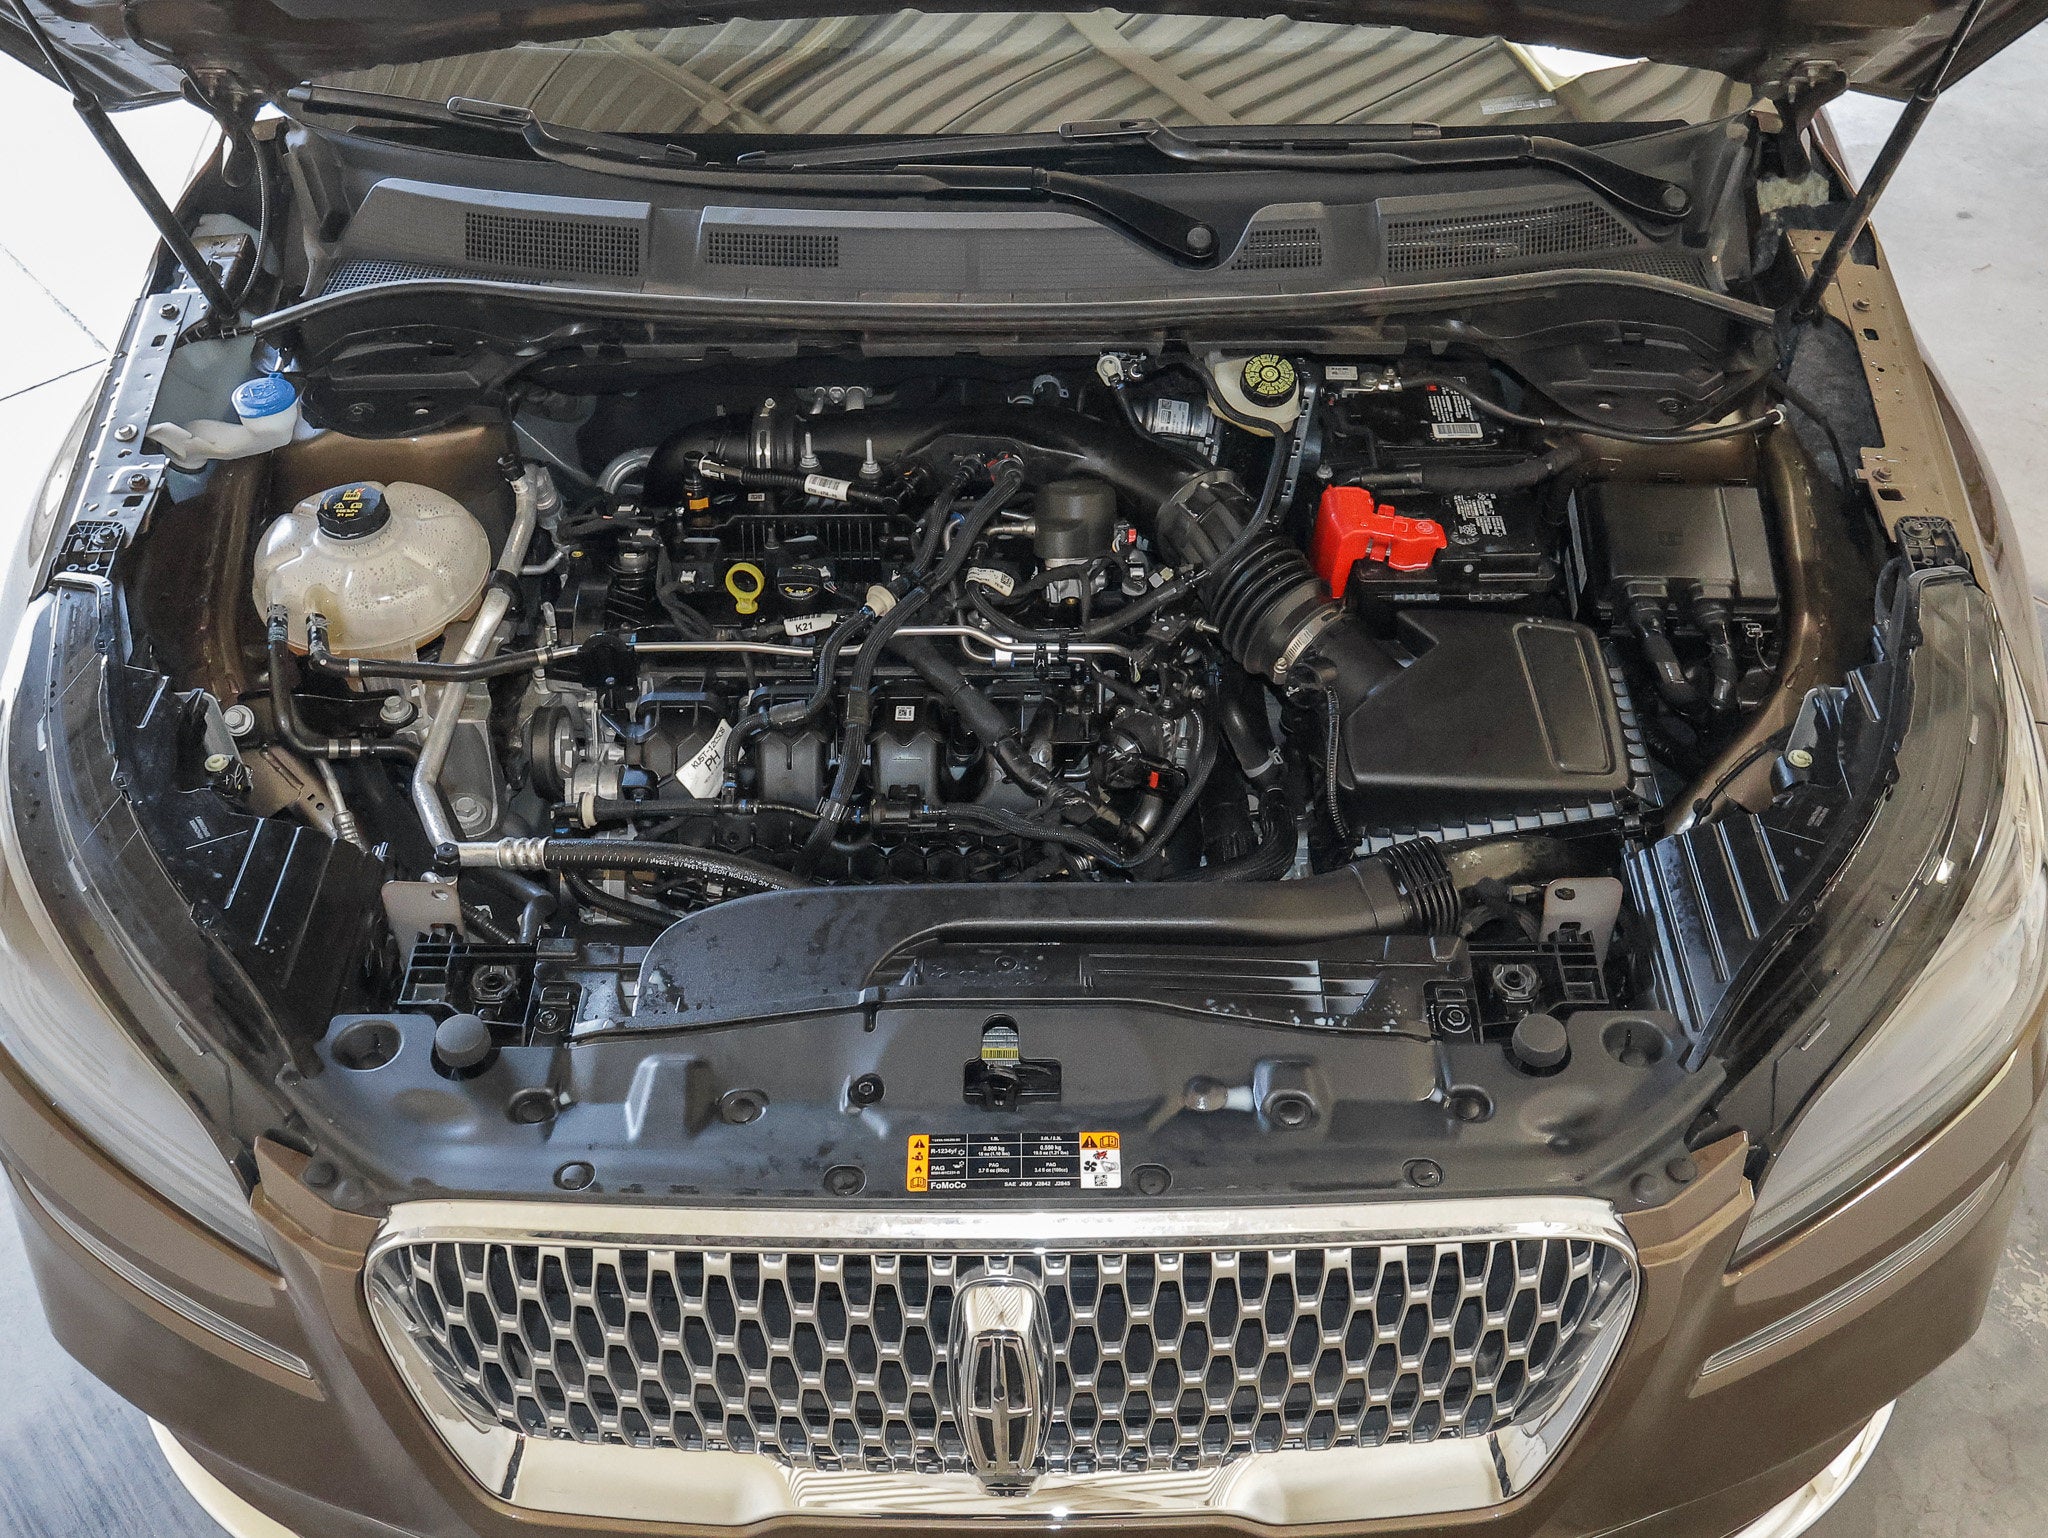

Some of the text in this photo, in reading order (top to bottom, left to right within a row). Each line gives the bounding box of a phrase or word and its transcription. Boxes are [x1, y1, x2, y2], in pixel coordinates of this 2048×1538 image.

[795, 621, 812, 632] K21
[704, 750, 721, 772] PH
[728, 872, 758, 884] SUCTION
